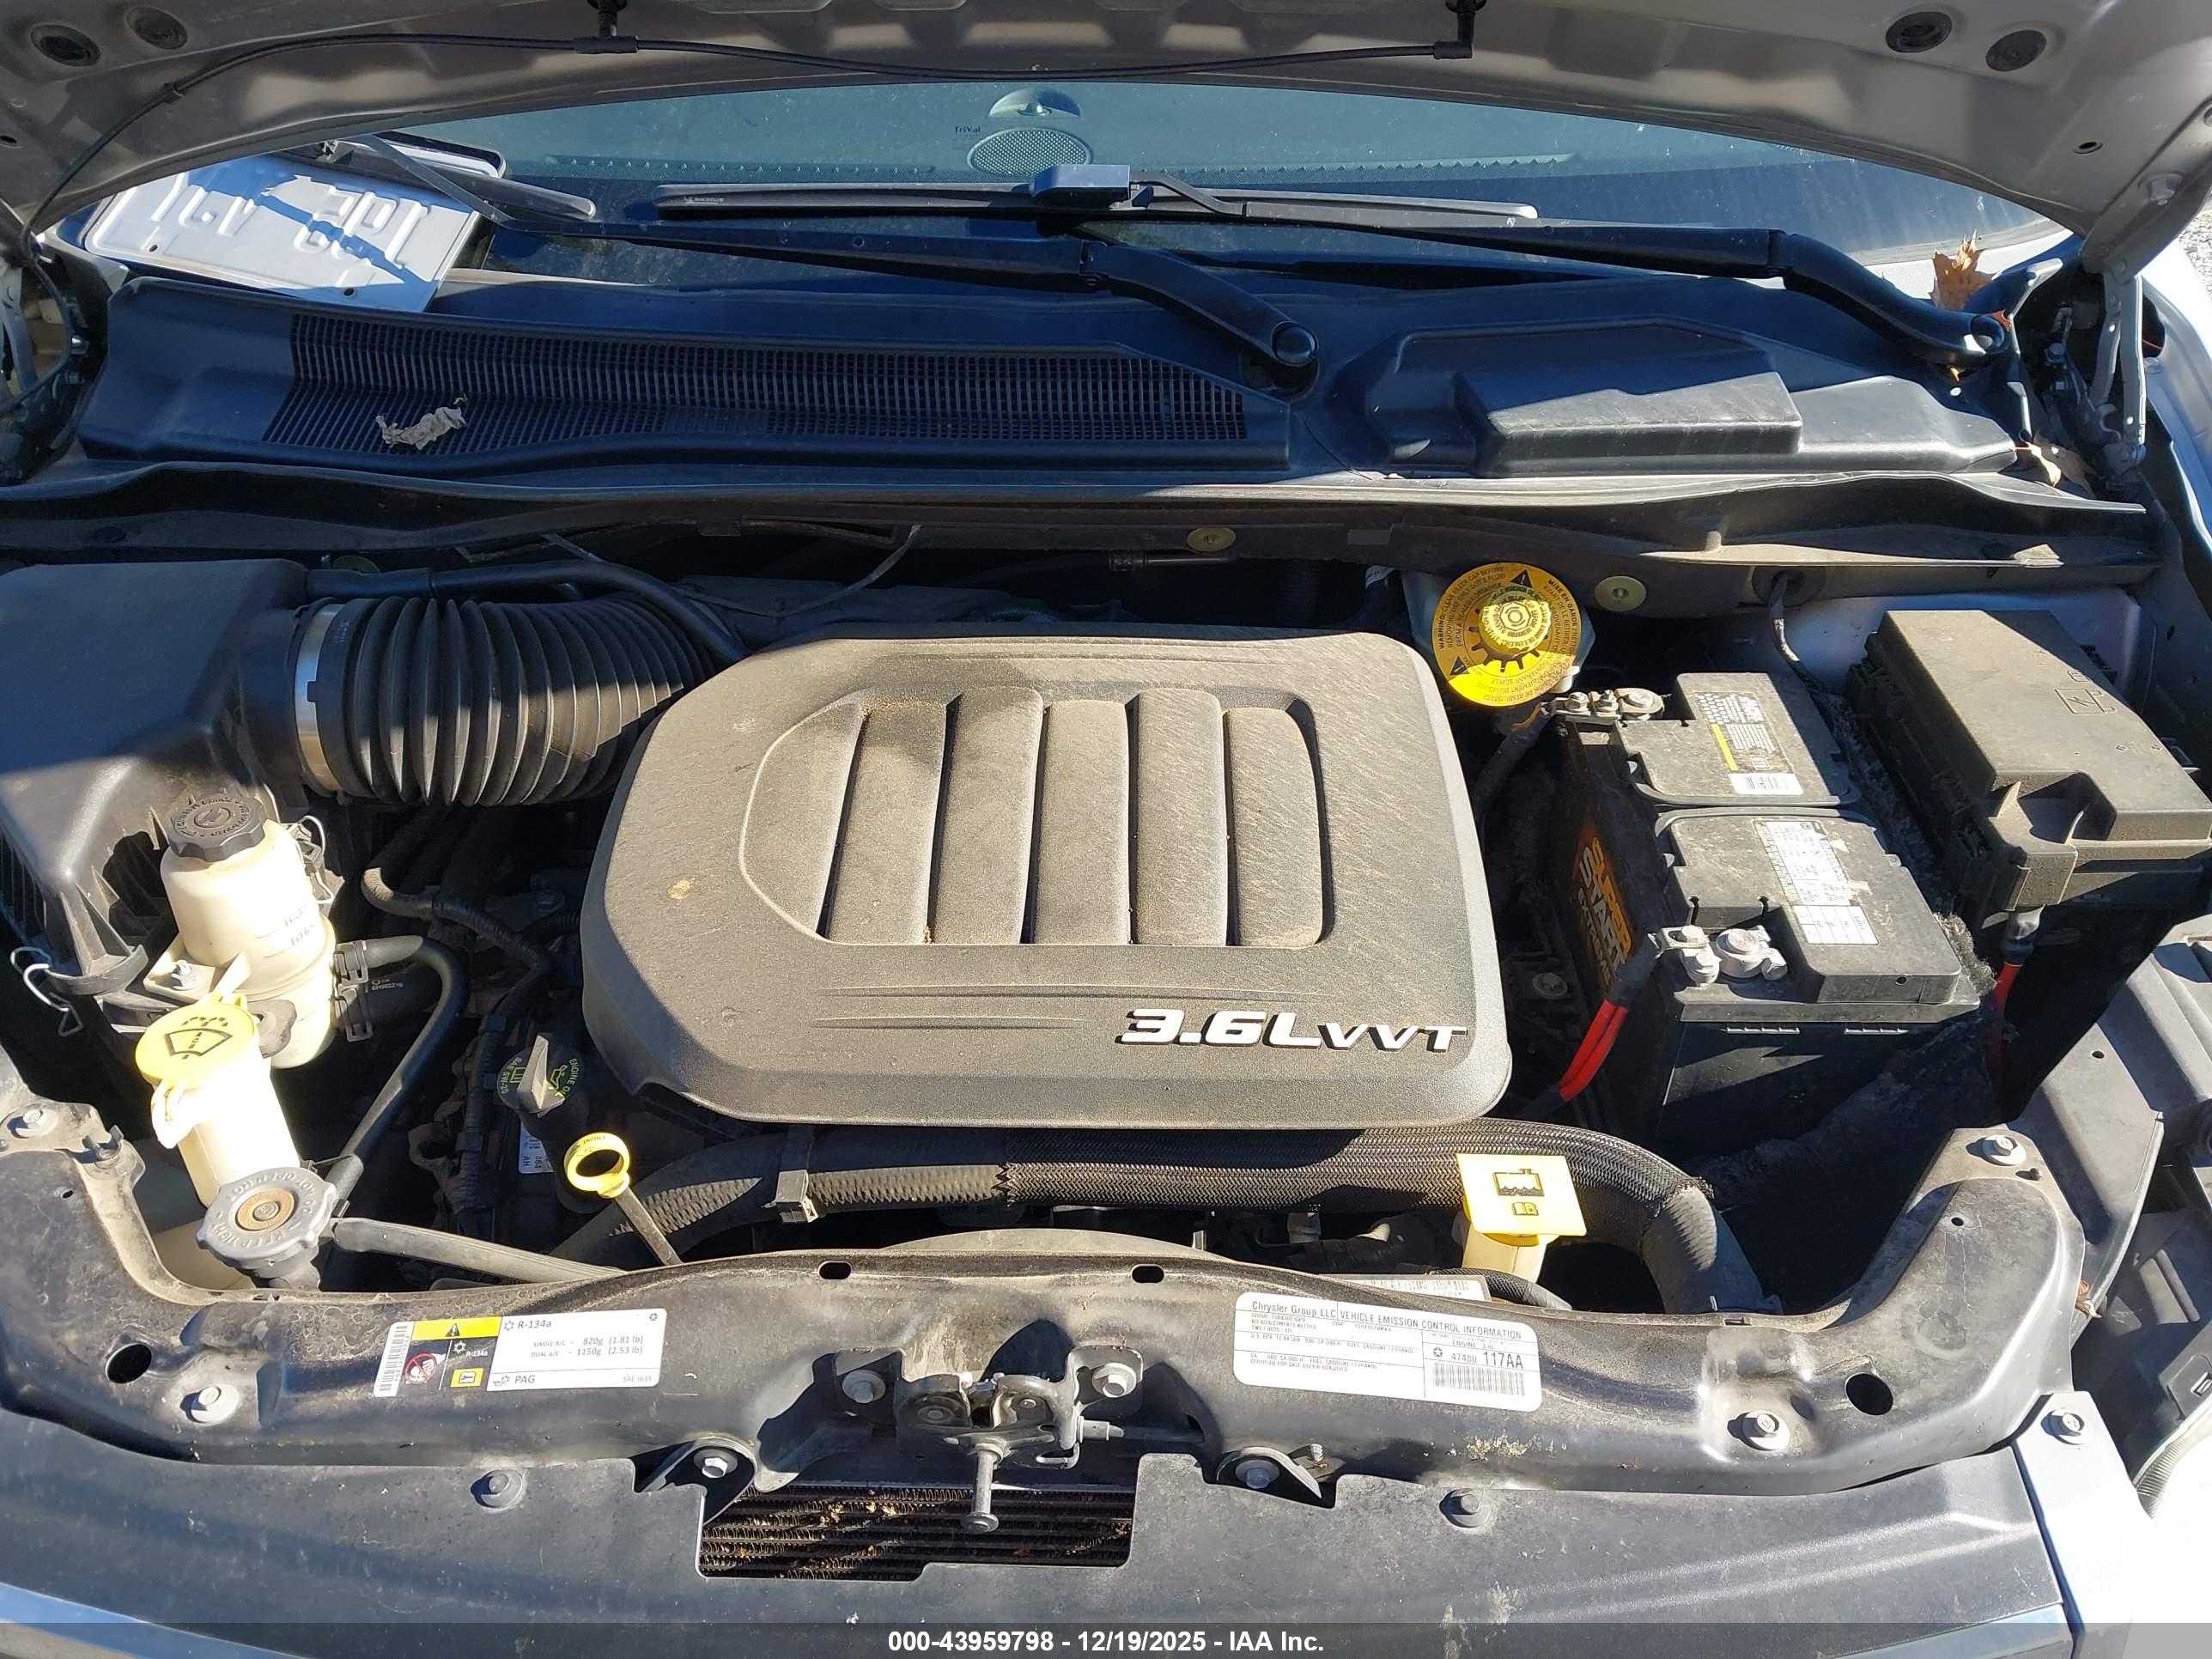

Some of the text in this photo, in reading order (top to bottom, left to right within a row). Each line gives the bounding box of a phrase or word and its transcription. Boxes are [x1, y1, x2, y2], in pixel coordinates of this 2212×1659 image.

[566, 1057, 579, 1086] ENGINE
[1251, 1300, 1335, 1318] Chrysler Group LLC
[517, 1319, 552, 1330] R-134a
[1340, 1310, 1374, 1322] VEHICLE
[1377, 1314, 1418, 1328] EMISSION
[1420, 1319, 1460, 1333] CONTROL
[1462, 1323, 1522, 1340] INFORMATION
[583, 1337, 604, 1346] 820g
[576, 1347, 602, 1357] 1150g
[1482, 1350, 1523, 1370] 117AA
[514, 1374, 536, 1385] PAG
